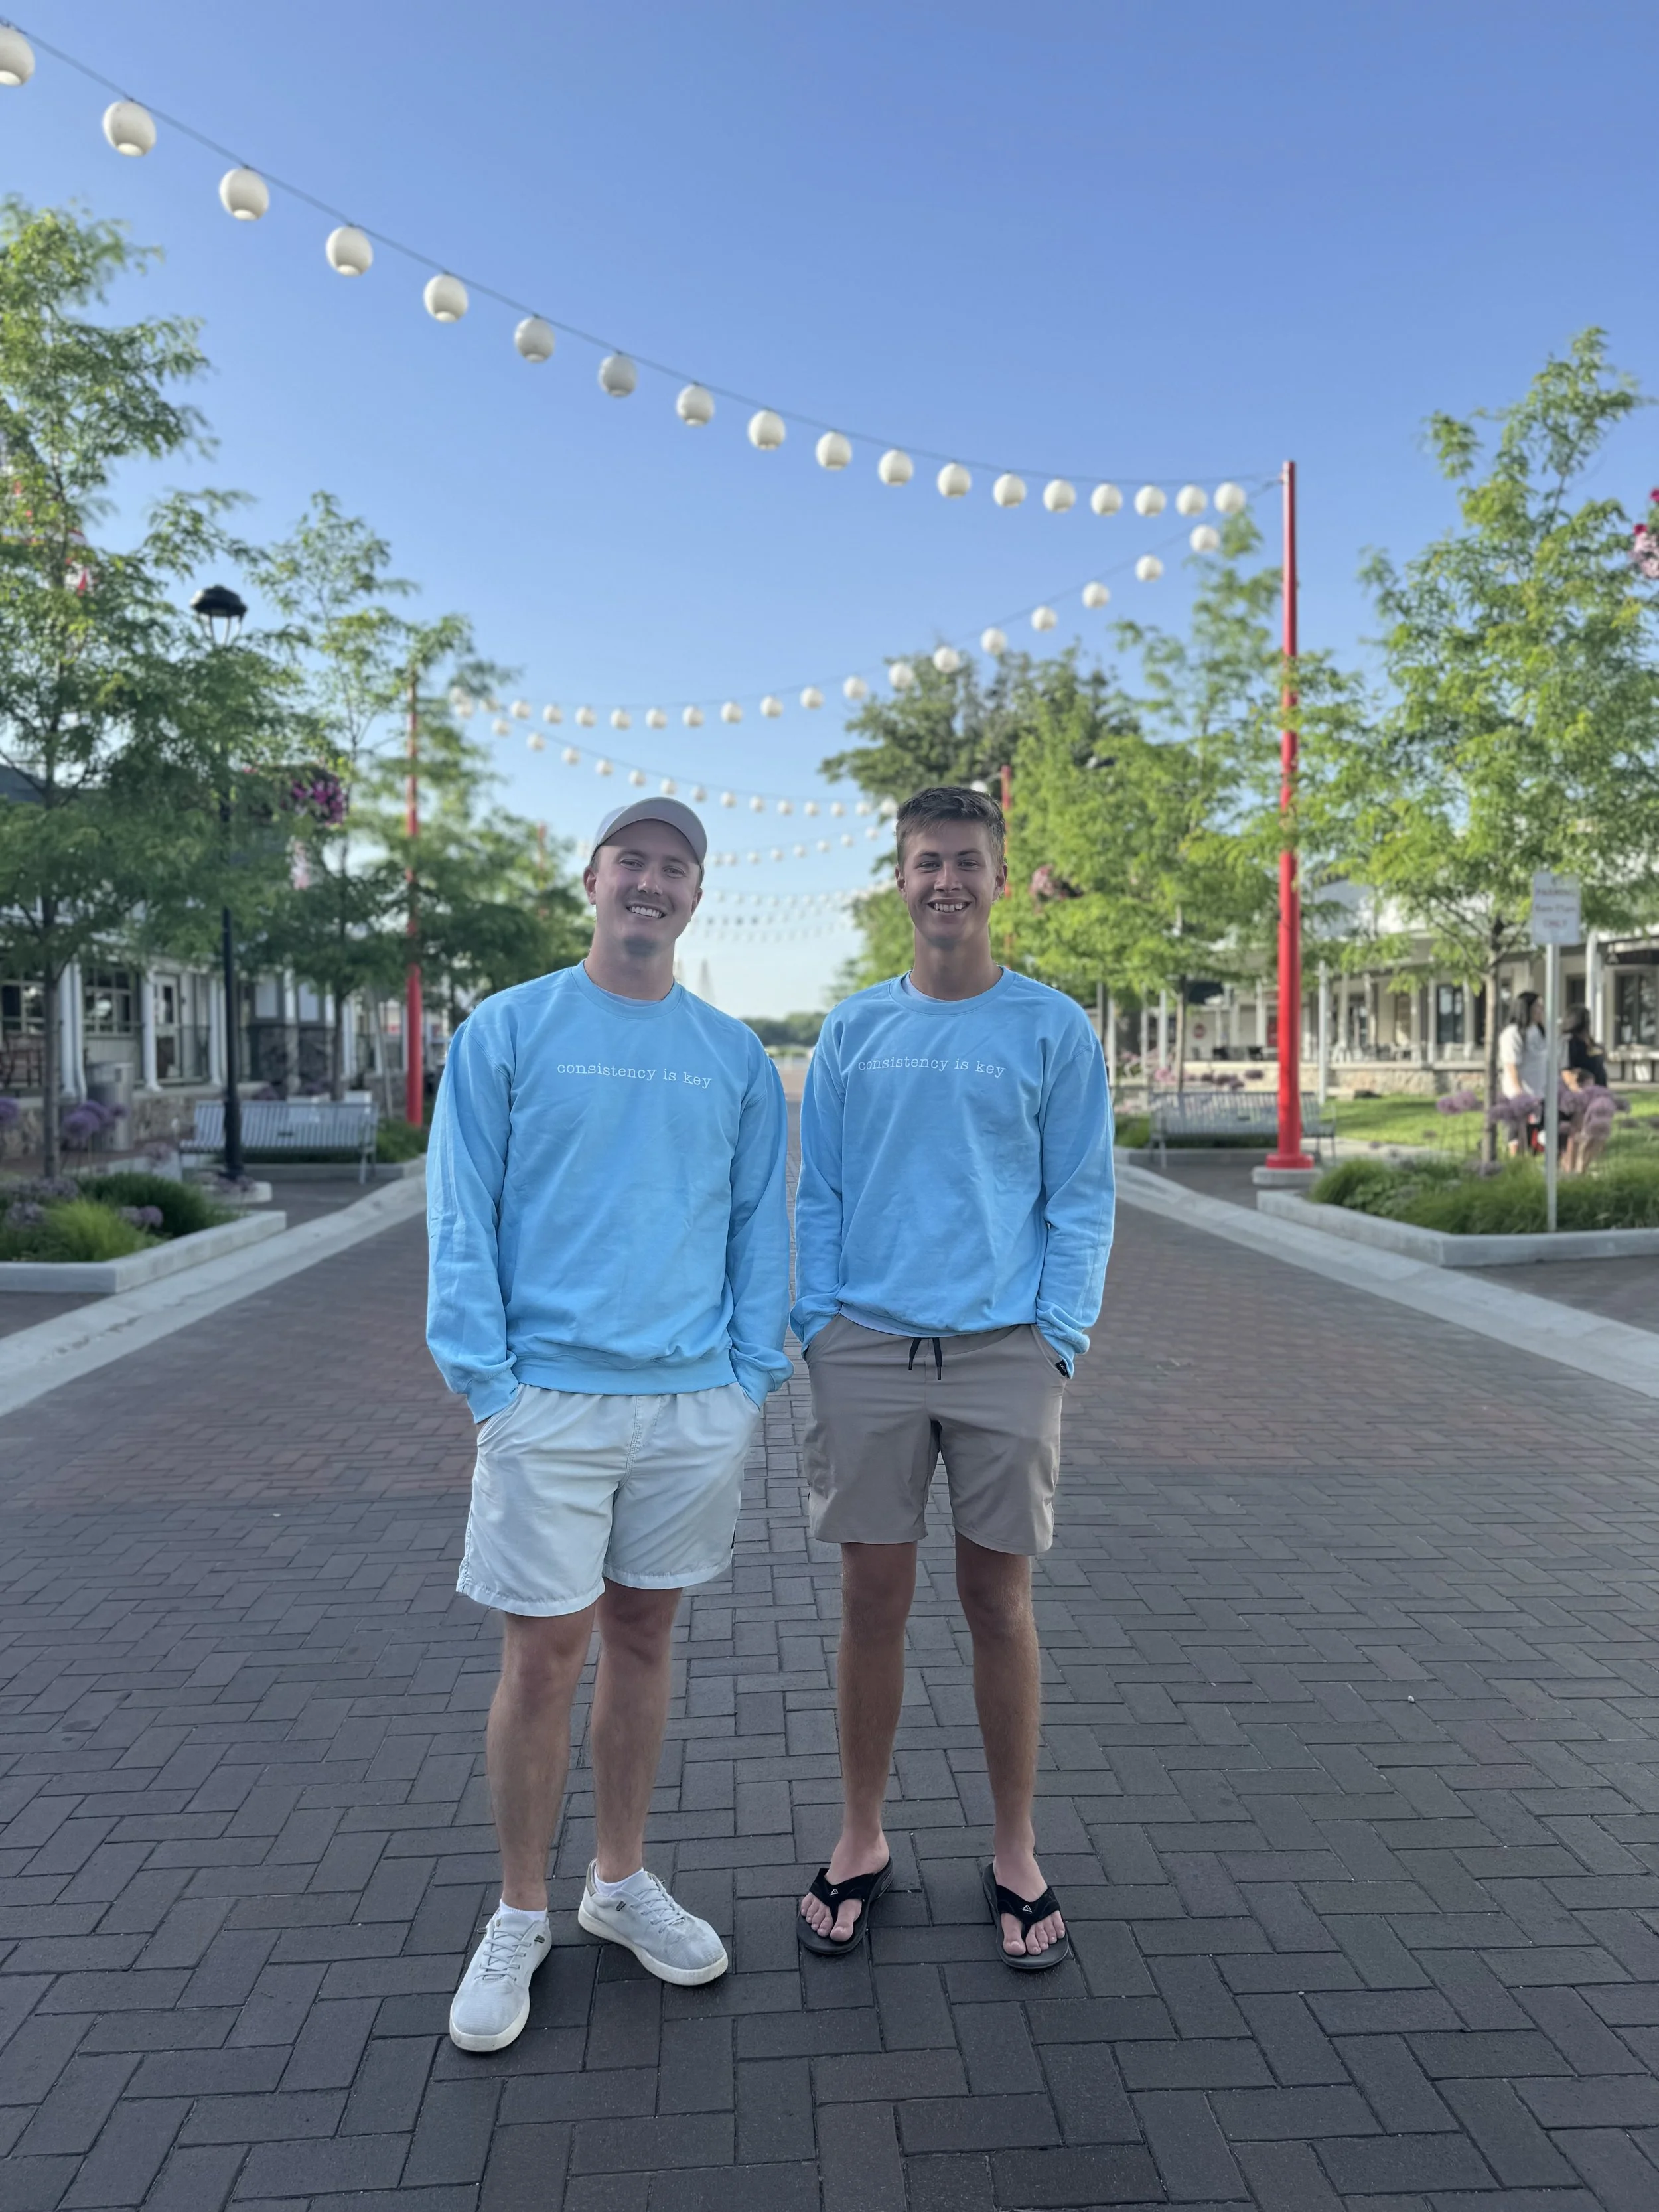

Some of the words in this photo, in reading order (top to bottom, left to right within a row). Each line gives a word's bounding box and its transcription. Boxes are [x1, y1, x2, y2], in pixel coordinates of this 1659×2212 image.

[557, 1063, 657, 1081] consistency
[662, 1069, 677, 1082] is
[683, 1072, 712, 1089] key
[858, 1056, 950, 1071] consistency
[954, 1058, 969, 1070] is
[975, 1061, 1006, 1078] key
